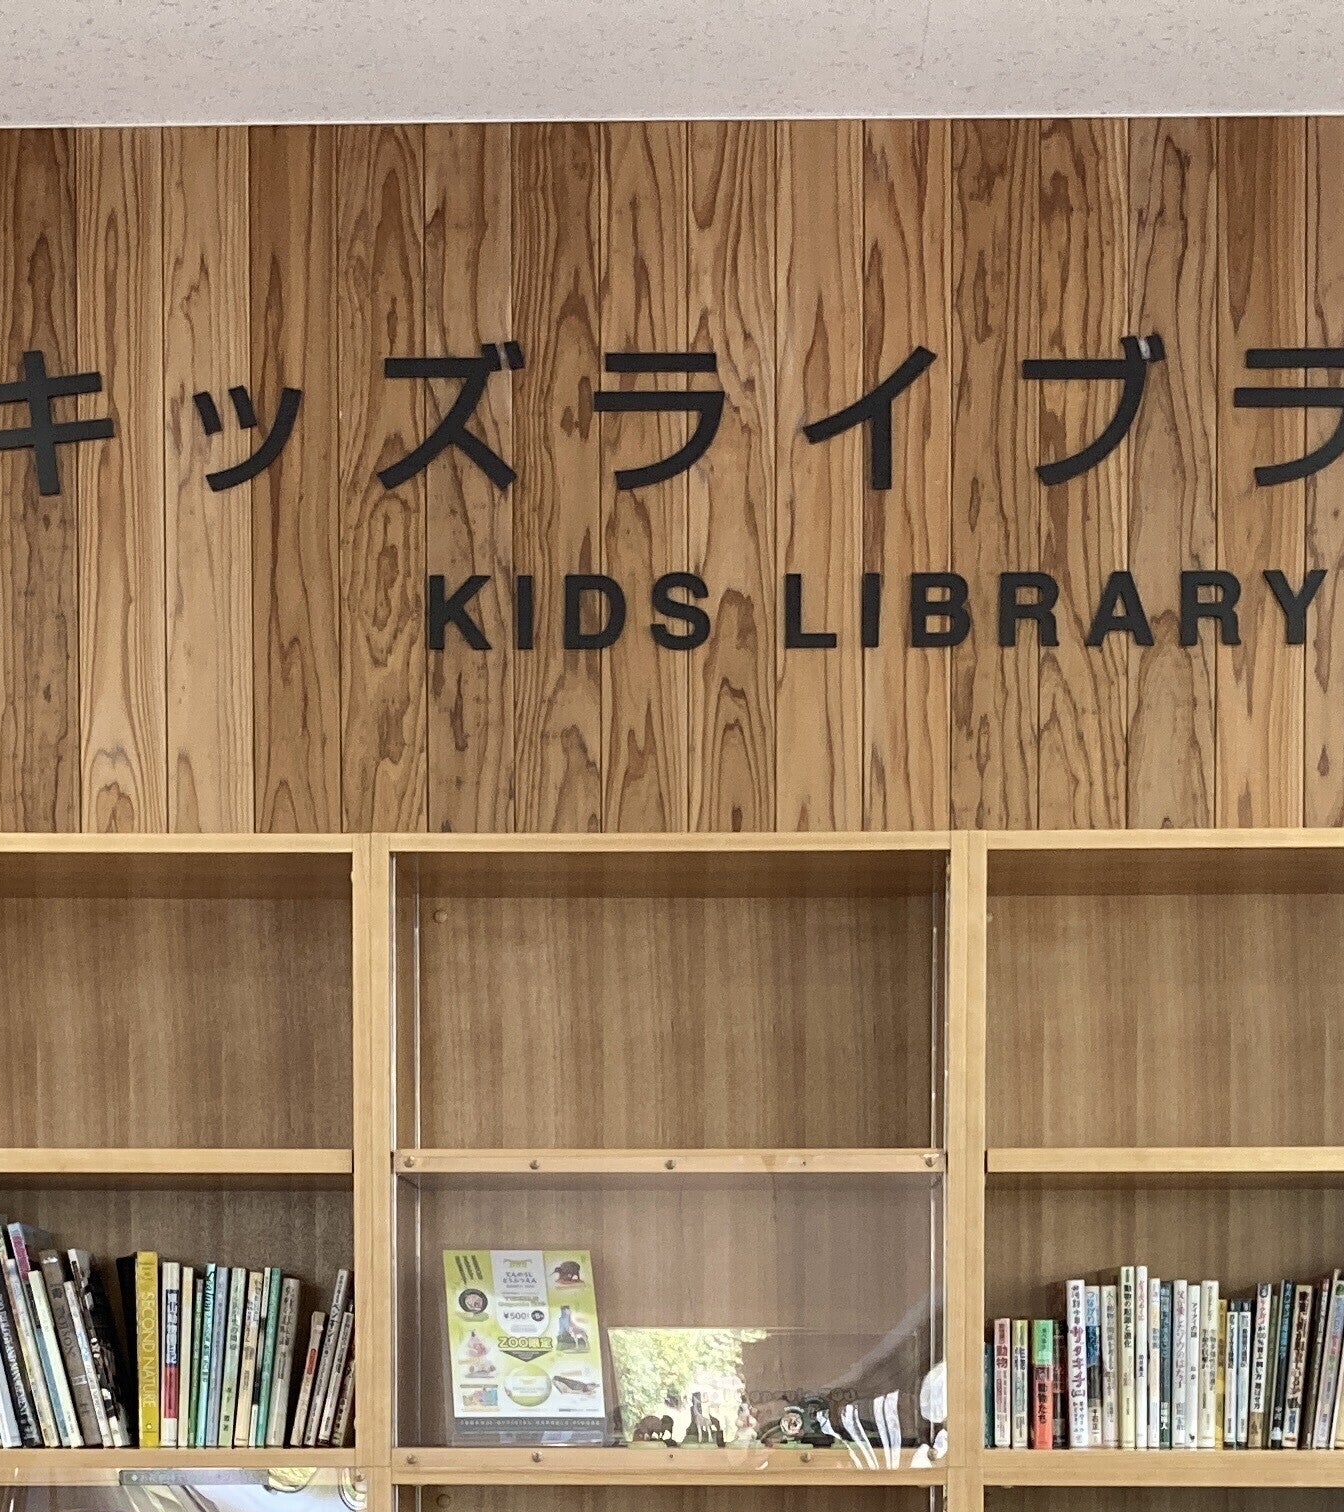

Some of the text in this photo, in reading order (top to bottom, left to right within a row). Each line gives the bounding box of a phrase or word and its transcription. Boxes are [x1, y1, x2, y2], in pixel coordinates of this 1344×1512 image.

[427, 572, 1331, 652] KIDS LIBRARY
[140, 1292, 156, 1408] SECOND NATURE
